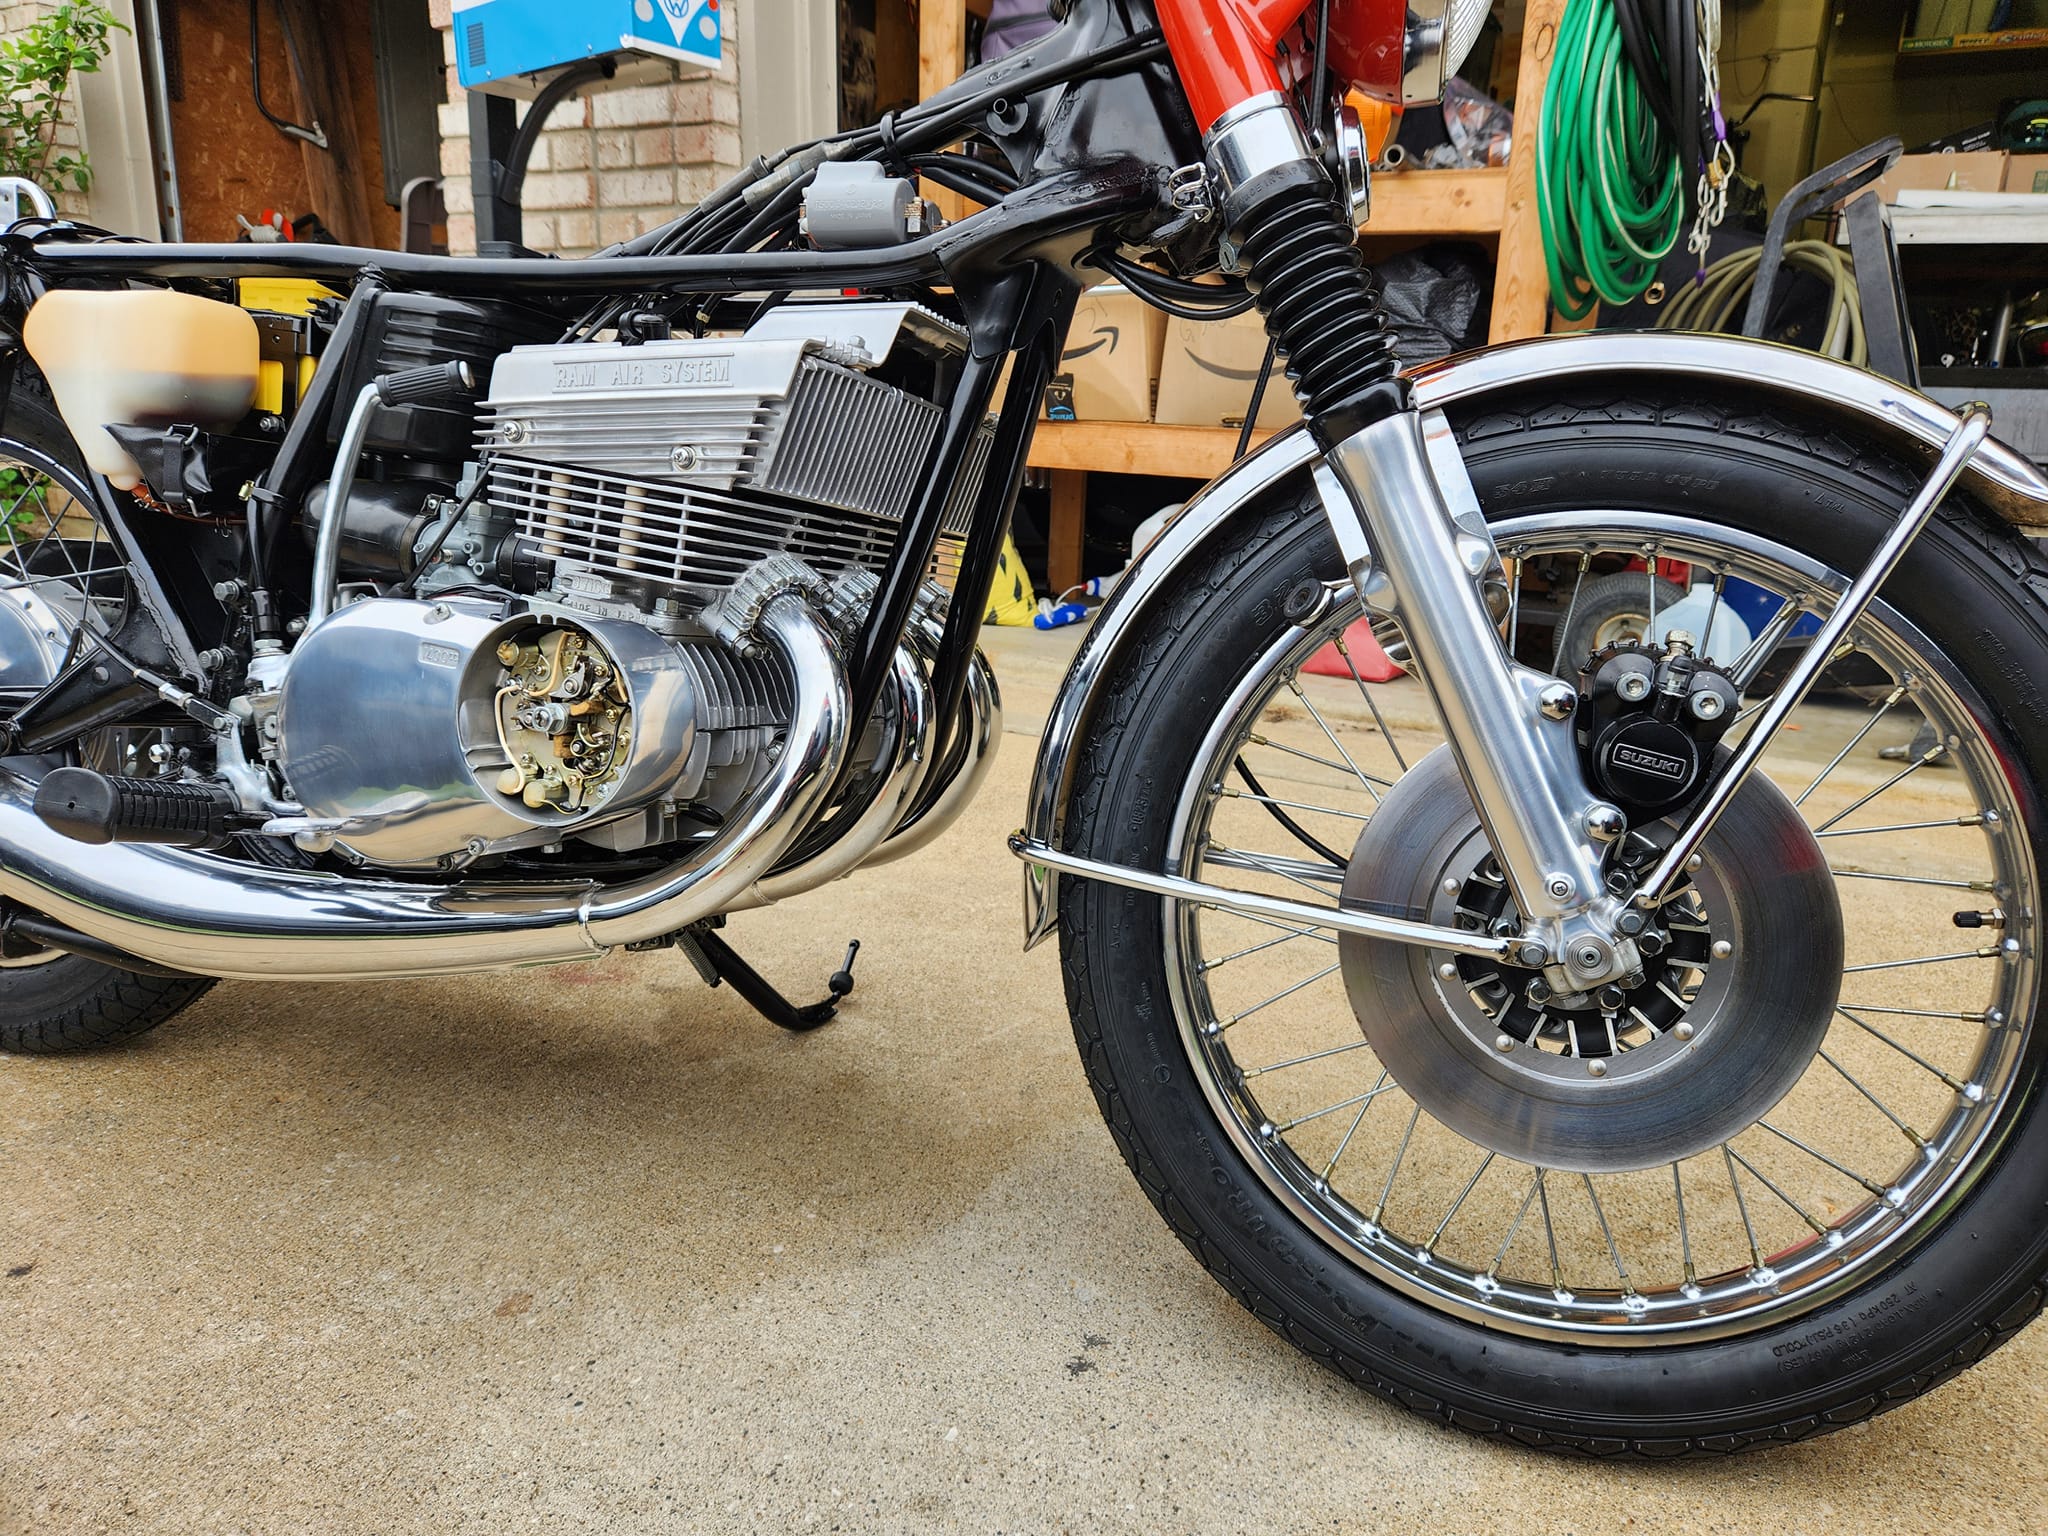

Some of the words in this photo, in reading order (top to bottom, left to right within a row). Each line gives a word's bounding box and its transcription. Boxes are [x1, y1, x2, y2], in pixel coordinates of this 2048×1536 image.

[555, 364, 596, 388] RAM
[610, 362, 643, 385] AIR
[662, 359, 730, 384] SYSTEM
[1620, 750, 1680, 773] SUZUKI
